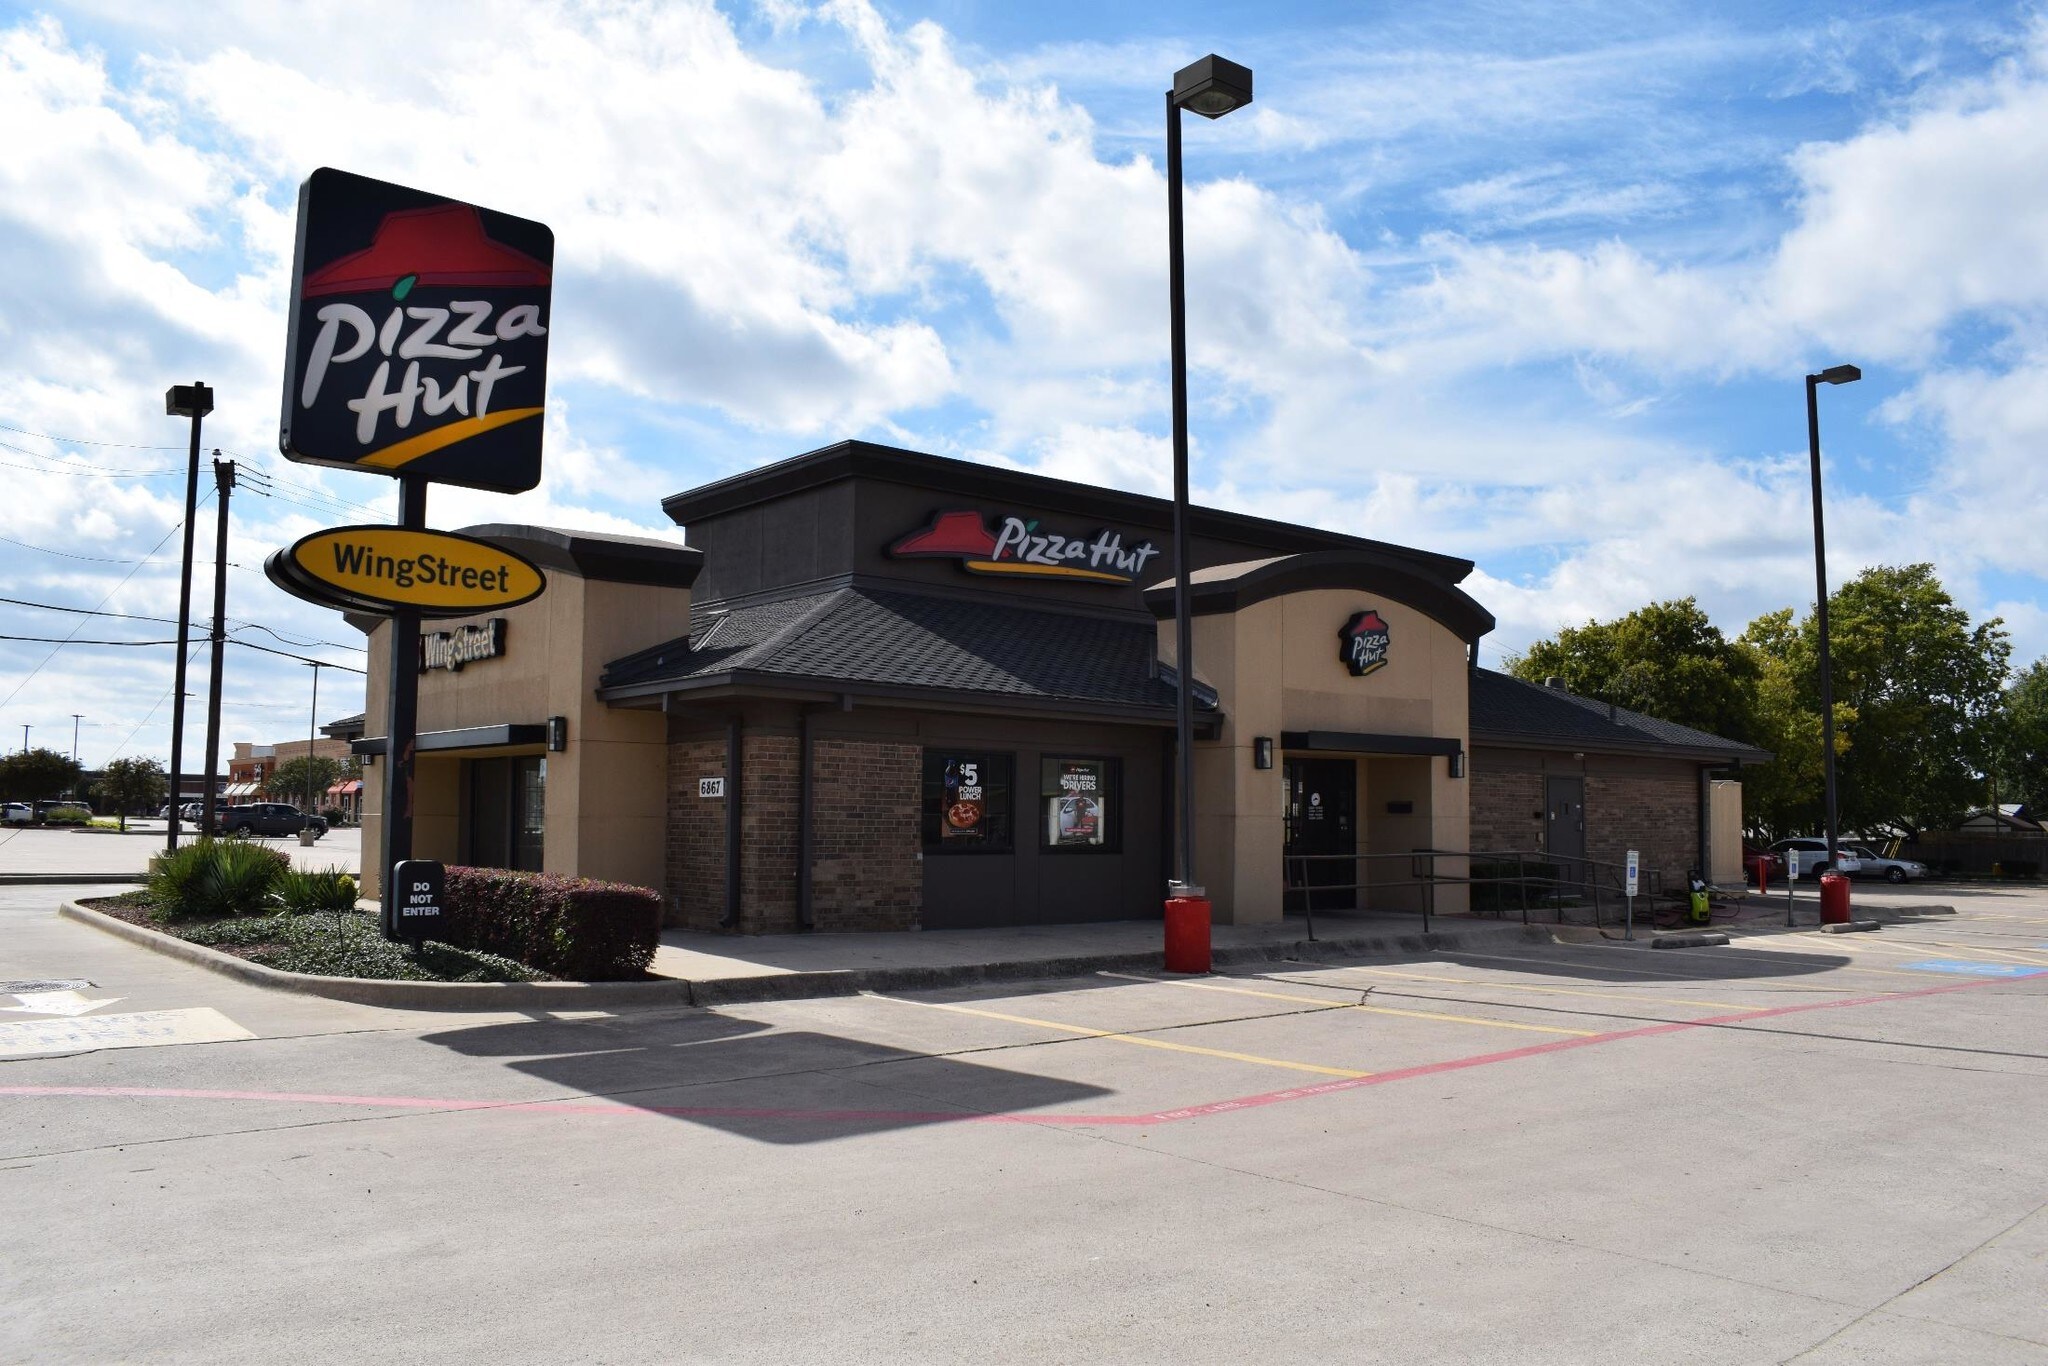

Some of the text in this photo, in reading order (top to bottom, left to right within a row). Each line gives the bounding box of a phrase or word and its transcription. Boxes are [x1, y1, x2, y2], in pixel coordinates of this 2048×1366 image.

[302, 274, 547, 410] Pizza
[347, 354, 527, 445] Hut
[992, 517, 1160, 573] Pizza Hut
[333, 542, 509, 593] WingStreet
[425, 621, 496, 672] WingStreet
[1352, 632, 1389, 659] Pizza
[1359, 648, 1384, 667] Hut
[959, 763, 978, 786] $5
[1063, 781, 1097, 791] DRIVERS
[702, 780, 720, 794] 6867
[413, 882, 430, 892] DO
[410, 894, 433, 904] NOT
[402, 907, 440, 916] ENTER
